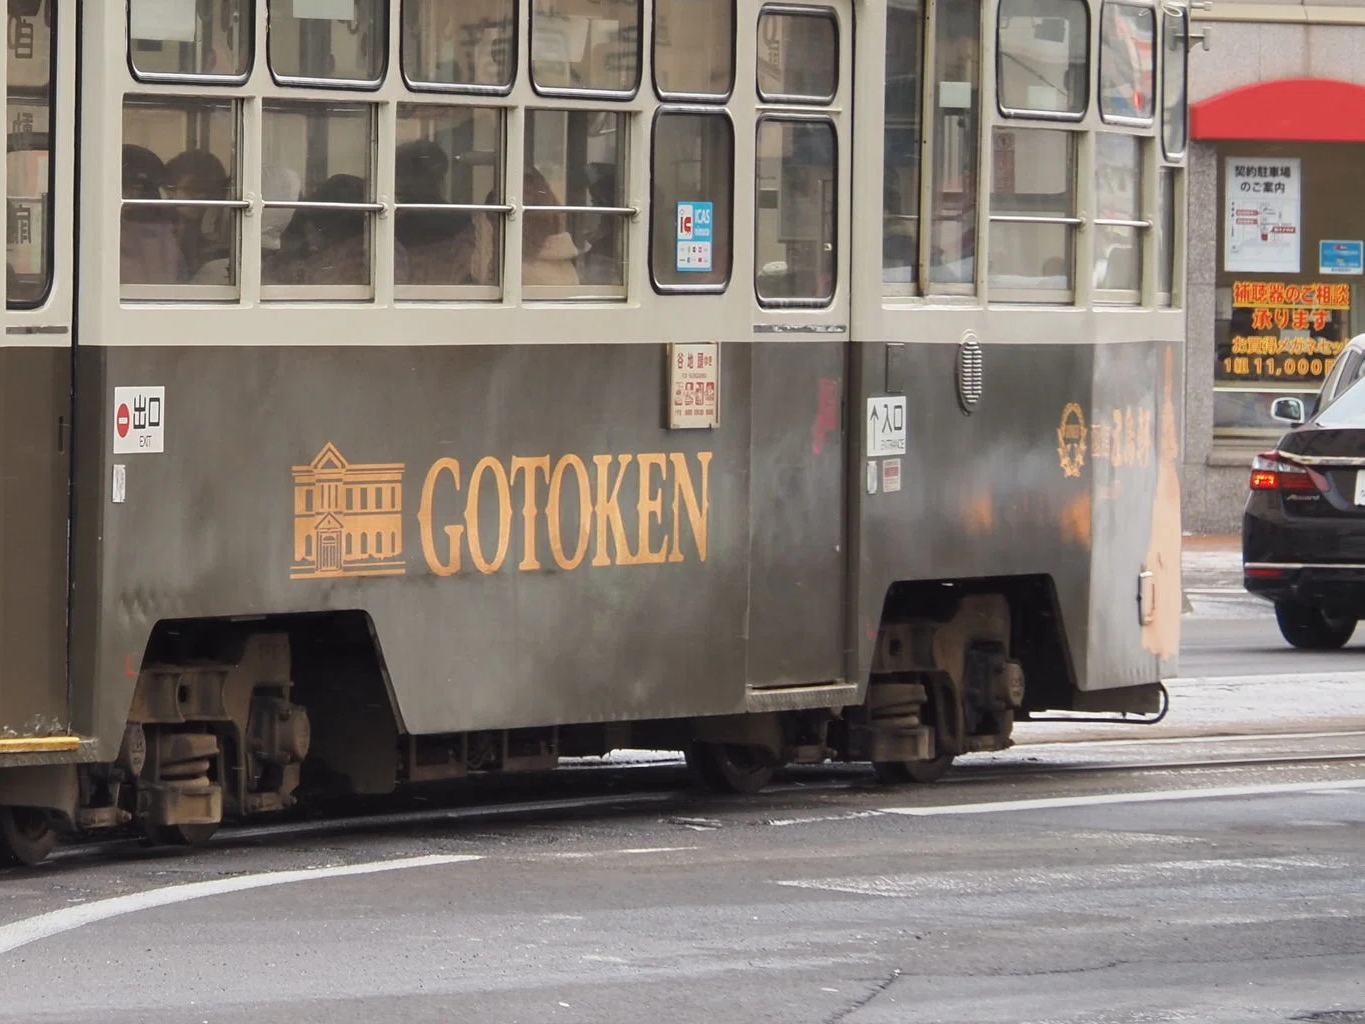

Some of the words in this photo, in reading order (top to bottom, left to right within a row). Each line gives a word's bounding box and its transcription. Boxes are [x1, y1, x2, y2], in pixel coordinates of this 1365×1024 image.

[1235, 165, 1291, 178] 契約駐車場
[1240, 182, 1285, 194] のご案内
[1234, 282, 1350, 304] 補聴器のご相談
[1252, 308, 1331, 331] 承ります
[1232, 336, 1351, 355] お買得メガネセッ
[133, 394, 160, 429] 出口
[882, 404, 902, 433] 入口
[417, 452, 713, 576] GOTOKEN
